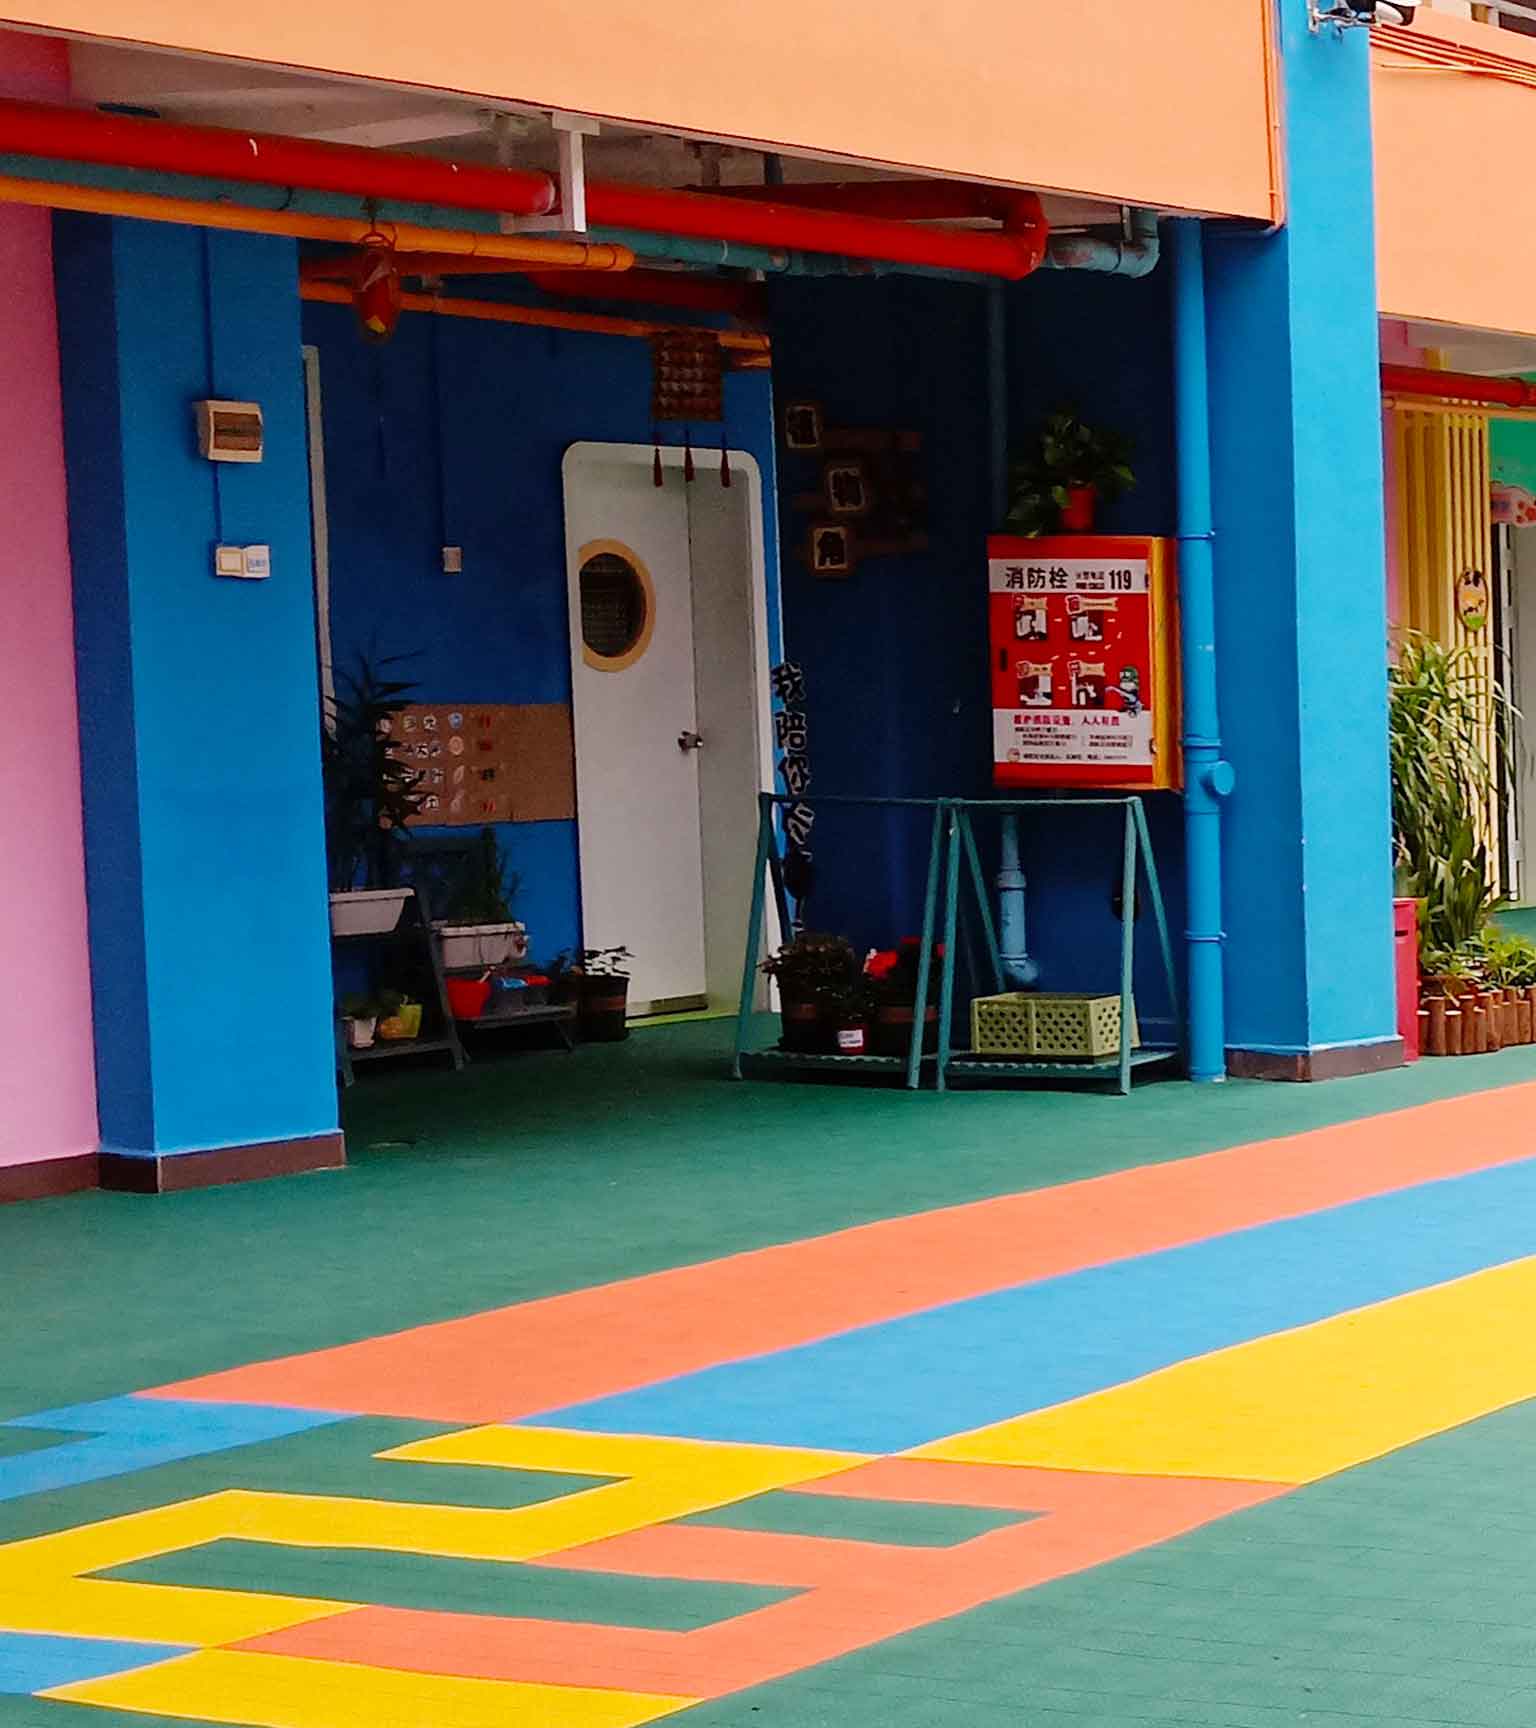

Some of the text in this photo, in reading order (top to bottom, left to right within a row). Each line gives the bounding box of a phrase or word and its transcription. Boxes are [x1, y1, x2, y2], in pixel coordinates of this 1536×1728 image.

[1005, 566, 1069, 590] 消防栓
[1108, 569, 1133, 590] 119
